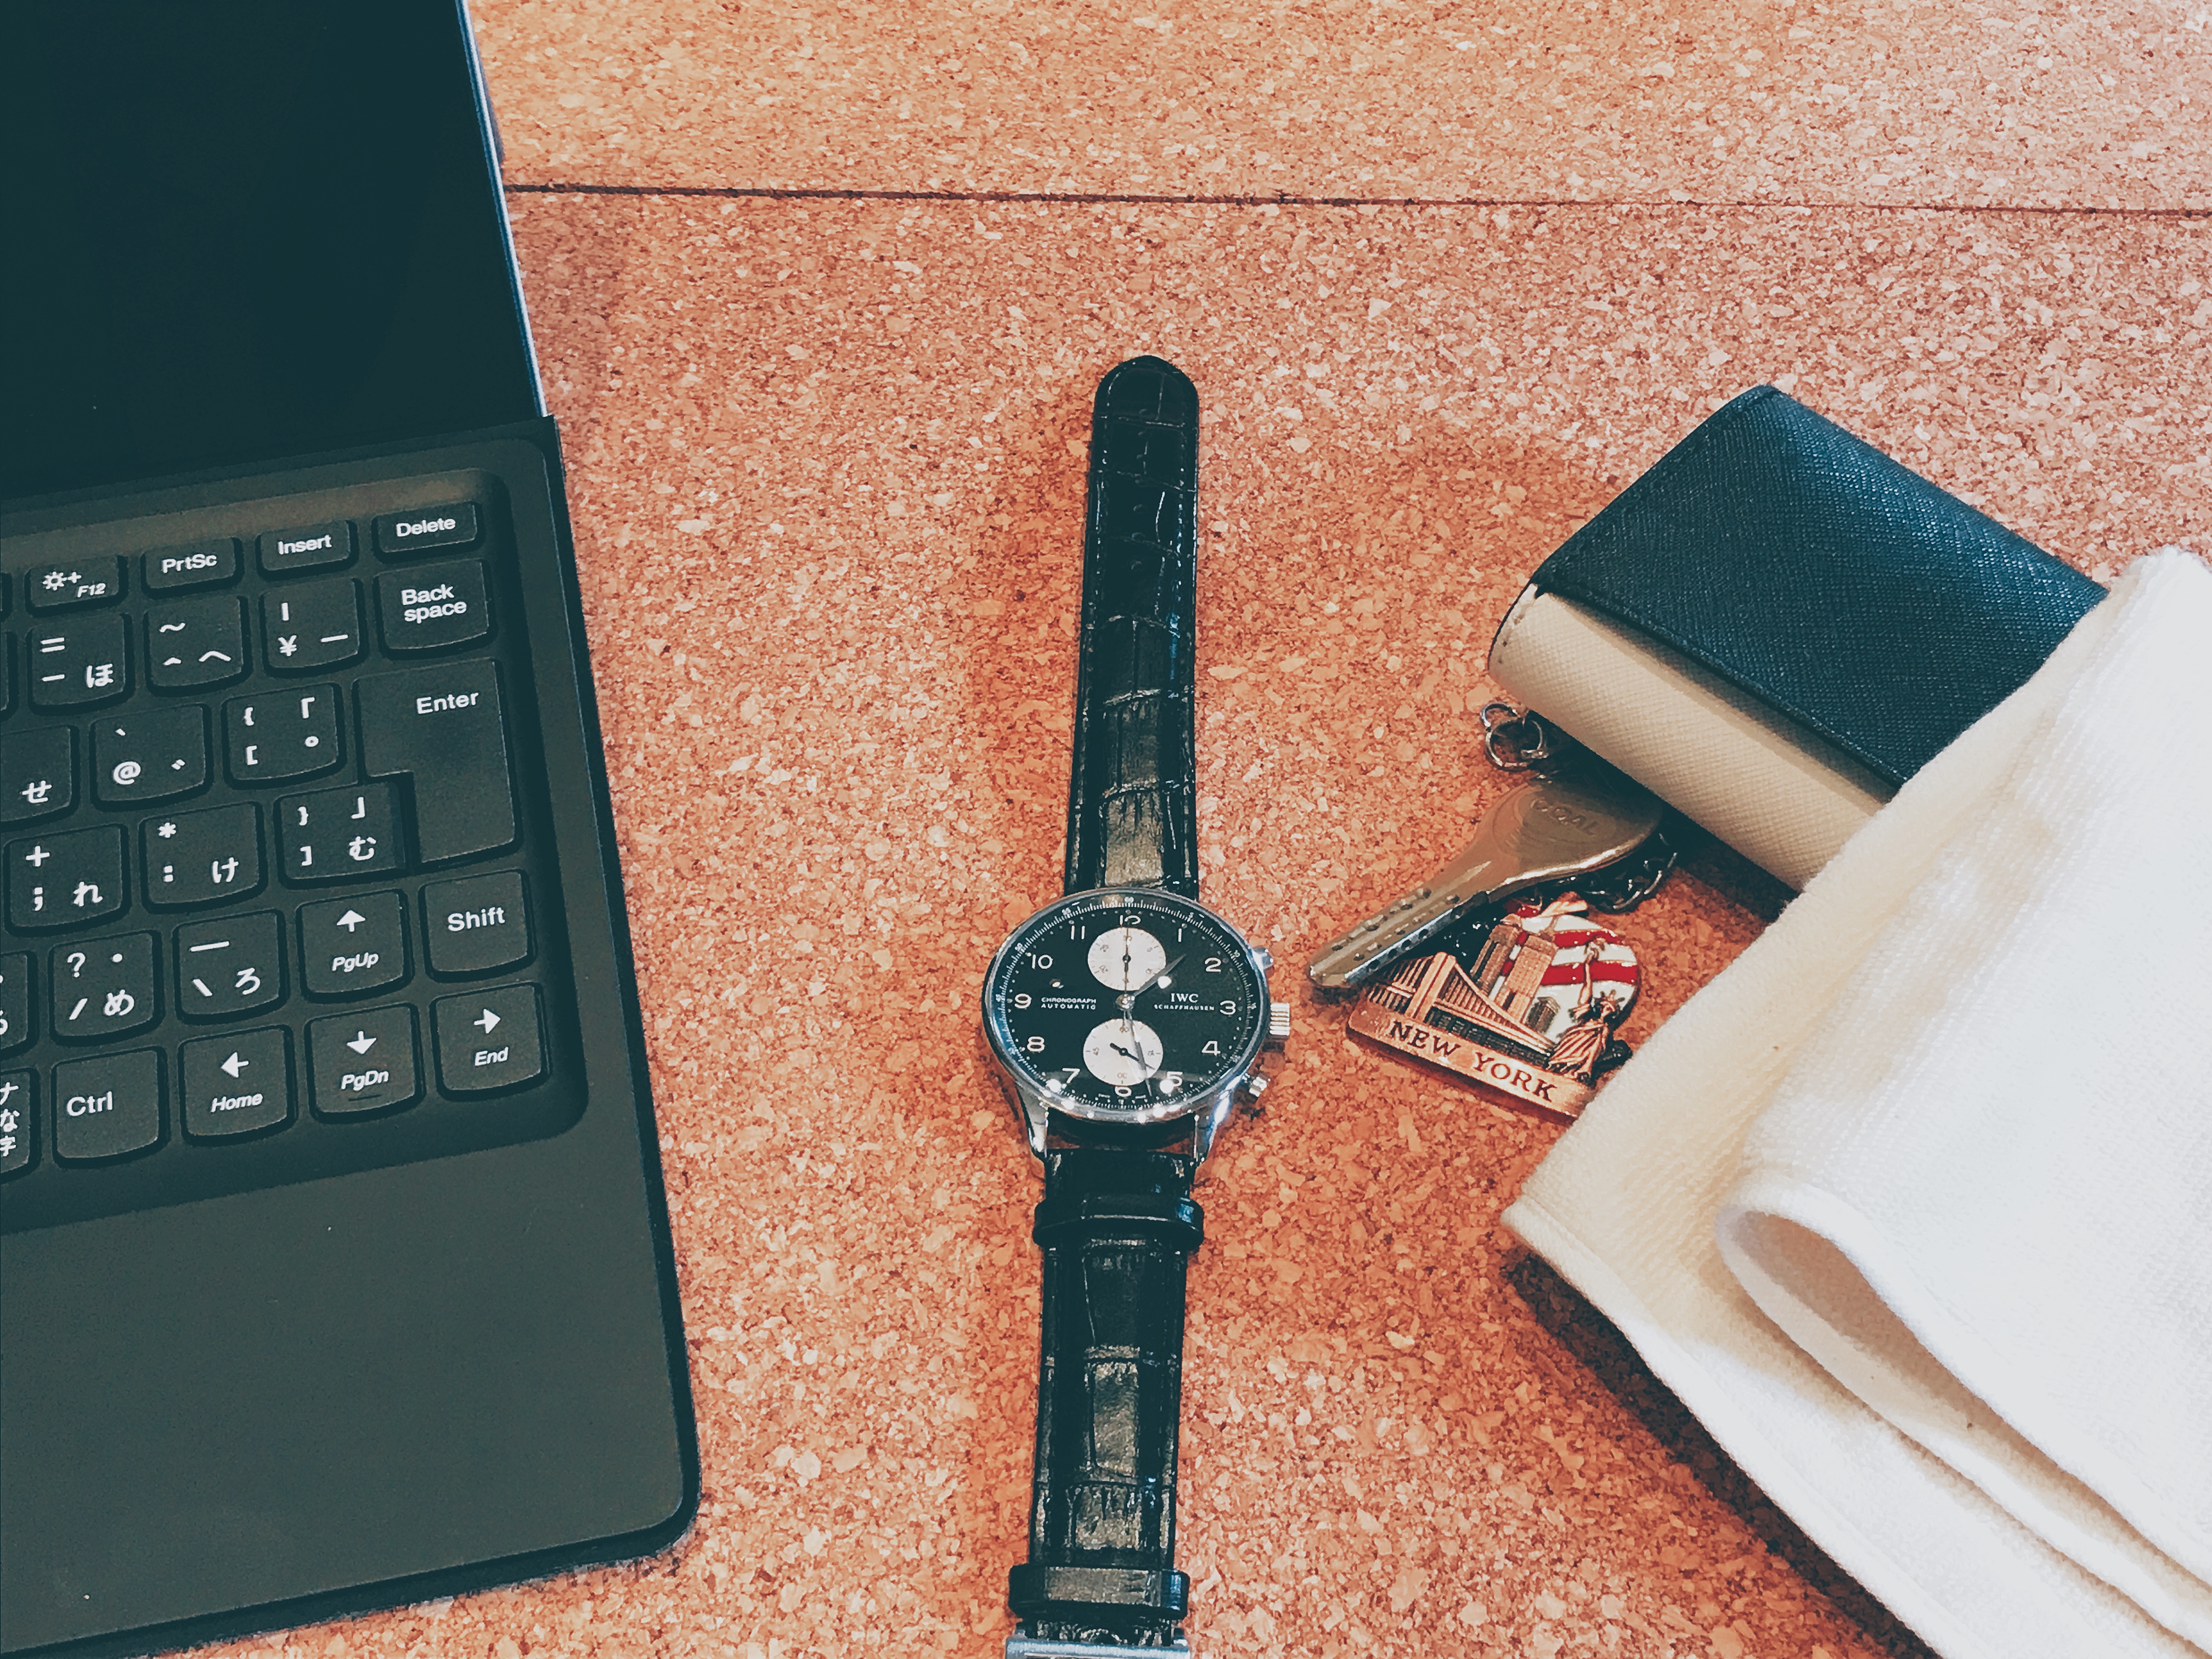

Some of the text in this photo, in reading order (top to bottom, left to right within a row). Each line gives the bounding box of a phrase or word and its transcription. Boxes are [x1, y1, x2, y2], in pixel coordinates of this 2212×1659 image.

[397, 518, 455, 537] Delete
[278, 535, 331, 554] Insert
[162, 554, 217, 573] PrtSc
[77, 583, 105, 597] F12
[401, 584, 454, 605] Back
[404, 600, 467, 623] space
[87, 664, 114, 688] ほ
[417, 693, 478, 714] Enter
[22, 781, 52, 803] せ
[349, 836, 376, 860] む
[212, 857, 239, 883] け
[74, 882, 103, 906] れ
[448, 907, 505, 931] Shift
[1071, 926, 1086, 940] 11
[332, 952, 379, 972] PgUp
[1032, 954, 1053, 969] 10
[1205, 957, 1222, 972] 2
[235, 968, 260, 995] ろ
[104, 990, 134, 1015] め
[1014, 994, 1031, 1008] 9
[1171, 992, 1199, 1003] IWC
[1220, 1001, 1236, 1015] 3
[1027, 1036, 1045, 1052] 8
[1201, 1041, 1221, 1056] 4
[475, 1047, 509, 1065] End
[1389, 1015, 1558, 1103] NEW YORK
[341, 1071, 388, 1091] PgDn
[1062, 1068, 1080, 1084] 7
[67, 1091, 112, 1116] Ctrl
[211, 1094, 263, 1112] Home
